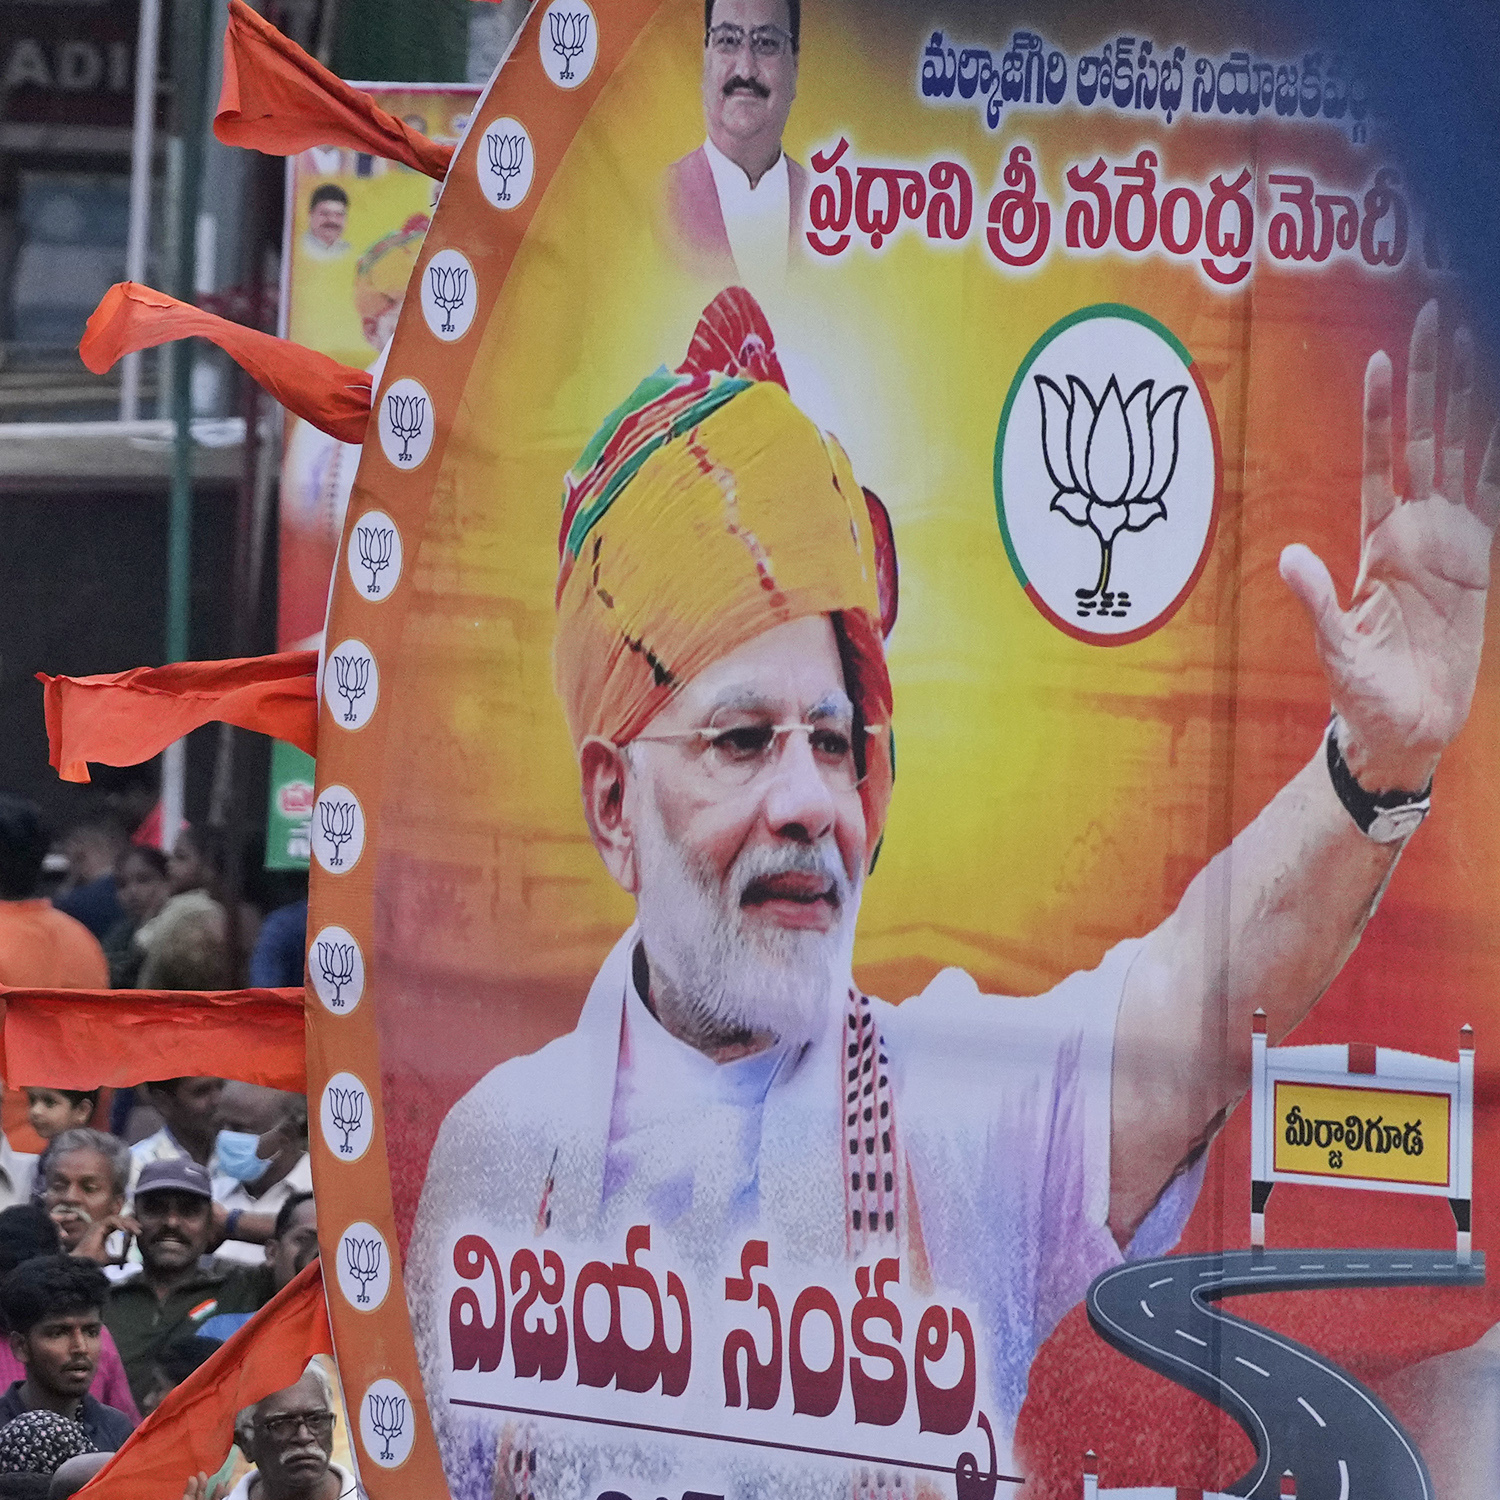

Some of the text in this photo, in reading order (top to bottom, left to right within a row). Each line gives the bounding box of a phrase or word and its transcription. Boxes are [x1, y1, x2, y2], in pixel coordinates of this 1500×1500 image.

[805, 136, 974, 256] ప్రధాని
[986, 145, 1050, 267] శ్రీ
[1065, 150, 1255, 285] నరేంద్ర
[449, 1225, 692, 1398] విజయ
